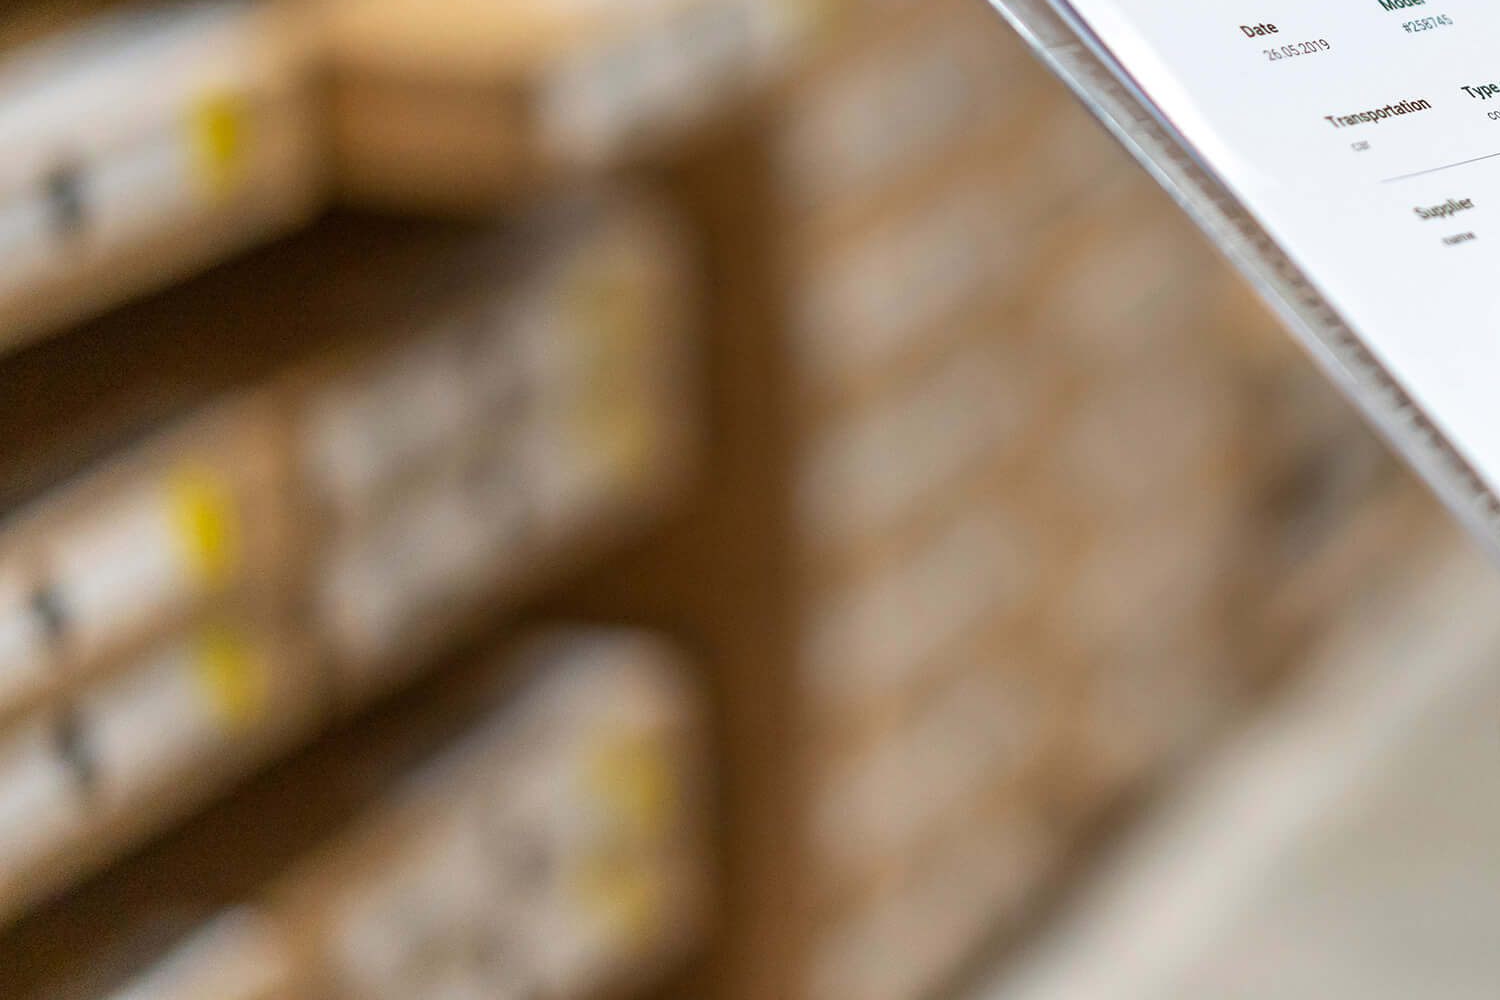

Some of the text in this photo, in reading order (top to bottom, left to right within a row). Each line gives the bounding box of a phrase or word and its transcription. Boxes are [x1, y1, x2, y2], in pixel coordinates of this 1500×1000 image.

[1239, 21, 1279, 38] Date
[1402, 14, 1454, 34] #258745
[1461, 80, 1500, 100] Type
[1324, 98, 1433, 128] Transportation
[1413, 198, 1475, 220] Supplier
